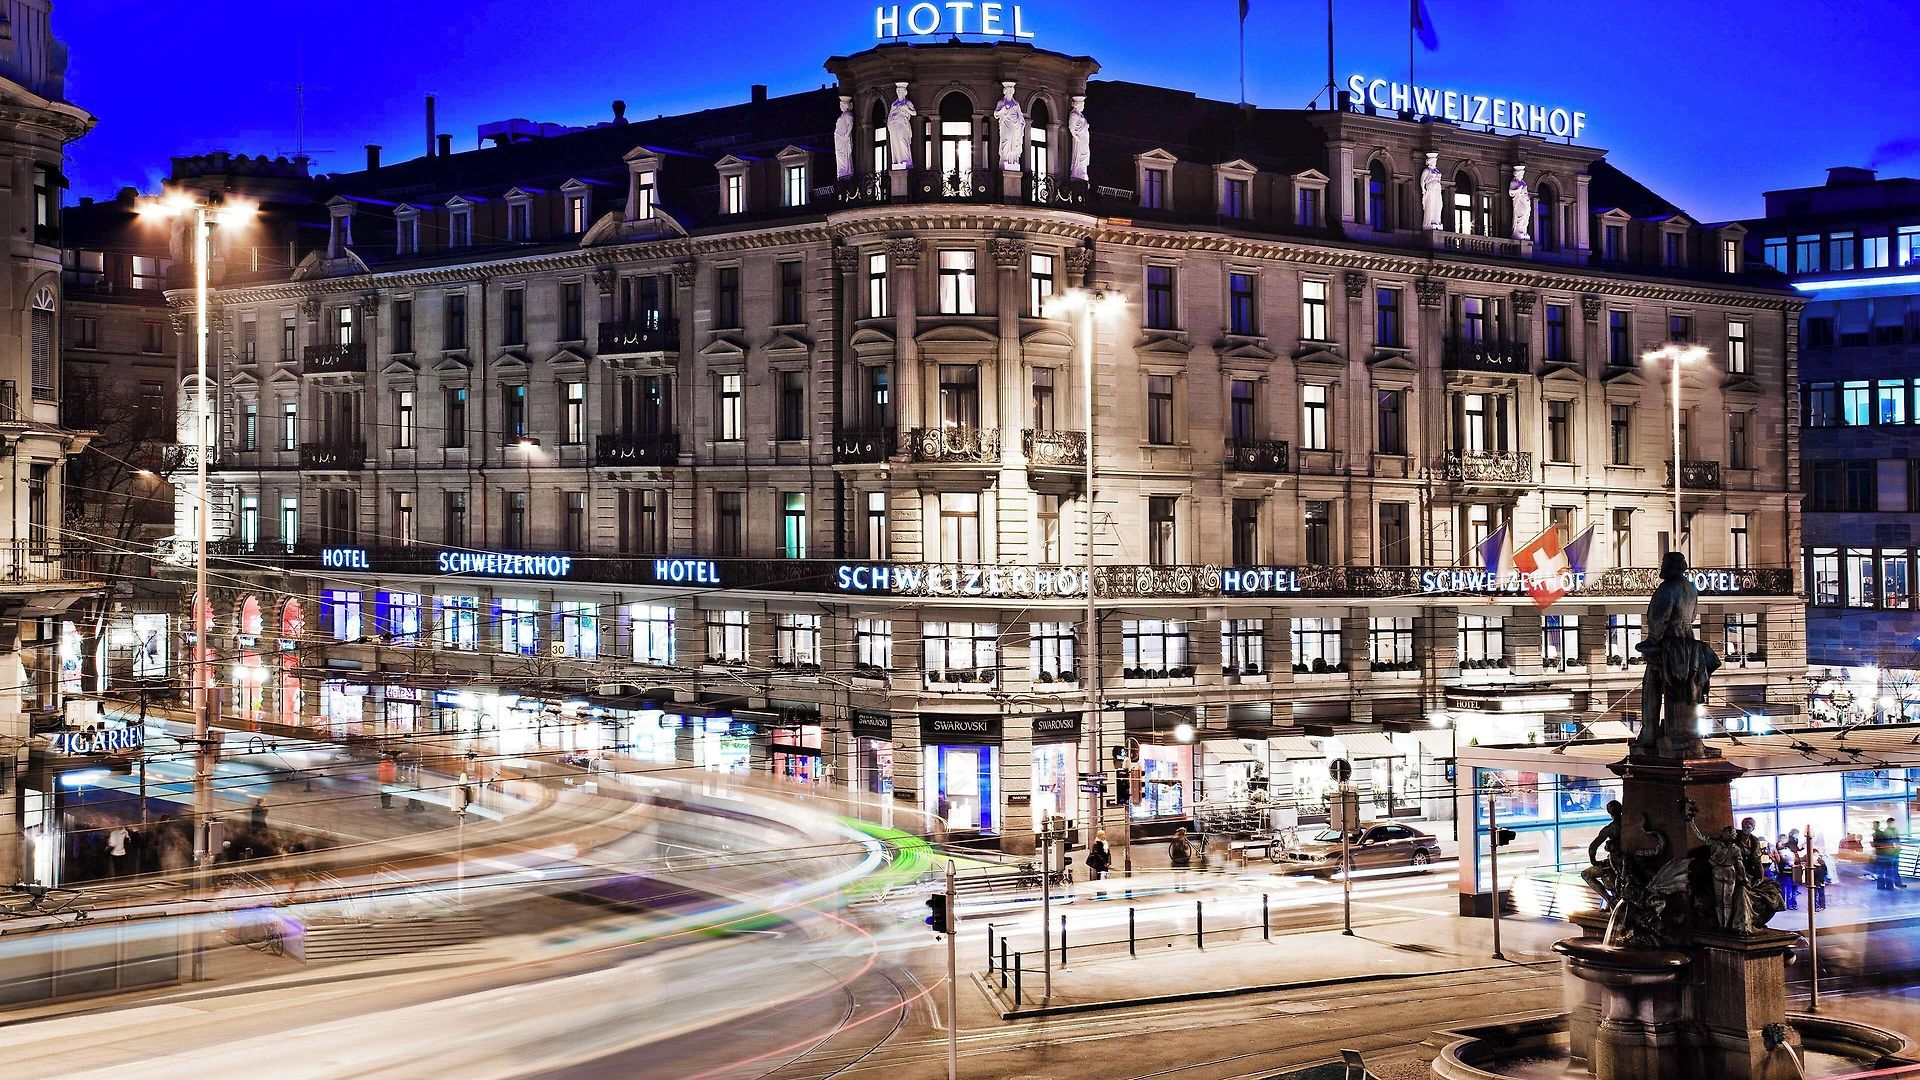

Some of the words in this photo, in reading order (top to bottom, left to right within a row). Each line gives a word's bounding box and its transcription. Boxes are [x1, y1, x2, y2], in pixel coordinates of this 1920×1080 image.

[875, 2, 1035, 38] HOTEL
[1348, 74, 1586, 138] SCHWEIZERHOF
[323, 549, 370, 568] HOTEL
[439, 552, 571, 576] SCHWEIZERHOF
[656, 560, 720, 583] HOTEL
[1224, 570, 1301, 592] HOTEL
[1423, 569, 1585, 593] SCHWEIZERHOF
[1689, 572, 1739, 592] OTEL
[552, 645, 565, 654] 30
[1456, 700, 1480, 709] HOTEL
[934, 720, 987, 731] SWAROVSKI
[1038, 719, 1074, 730] SWAROVSKI
